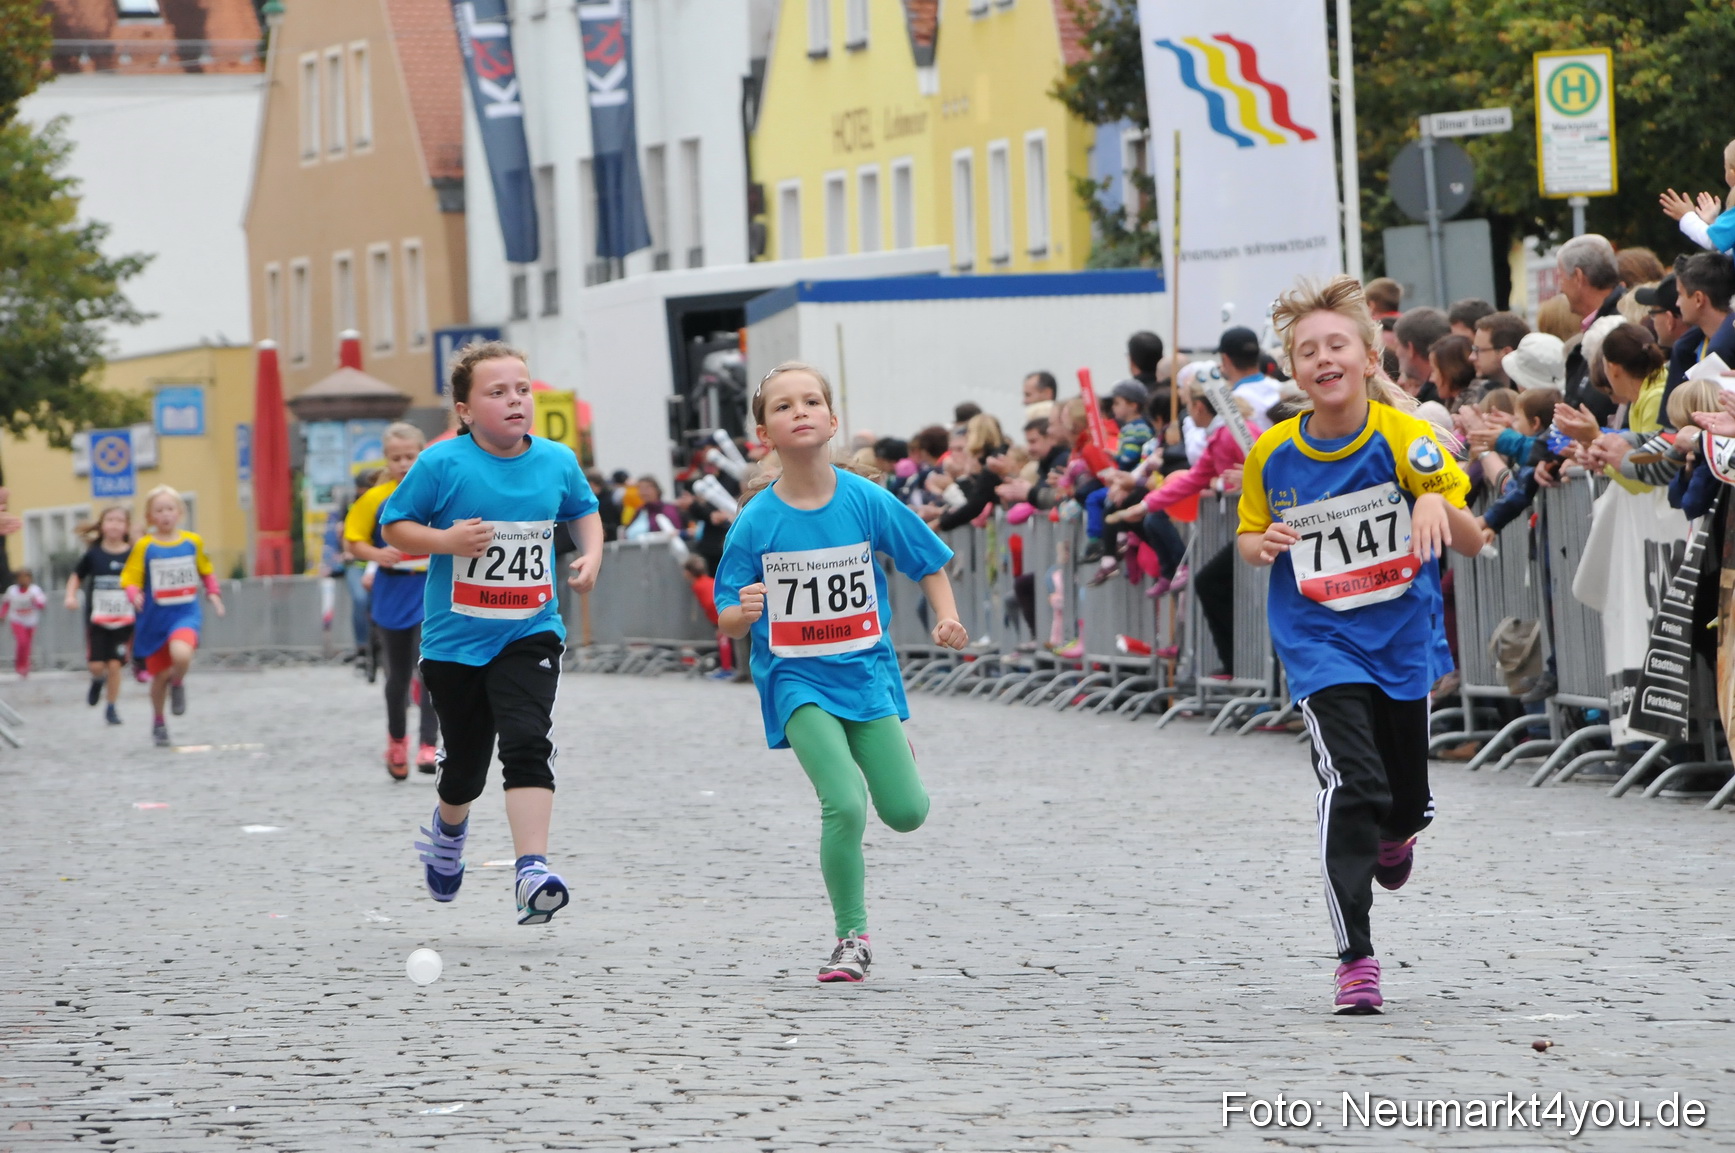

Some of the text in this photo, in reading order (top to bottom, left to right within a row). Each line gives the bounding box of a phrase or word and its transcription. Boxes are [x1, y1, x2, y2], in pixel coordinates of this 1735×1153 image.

[1561, 73, 1588, 104] H
[831, 107, 875, 154] HOTEL
[545, 411, 568, 441] D
[1421, 471, 1460, 492] PARTL
[1327, 497, 1384, 521] Neumarkt
[493, 531, 539, 541] Neumarkt
[1301, 511, 1398, 573] 7147
[467, 544, 544, 581] 7243
[766, 556, 858, 574] PARTL Neumarkt
[778, 570, 868, 615] 7185
[1324, 567, 1400, 597] Franziska
[480, 590, 529, 606] Nadine
[801, 624, 852, 642] Melina
